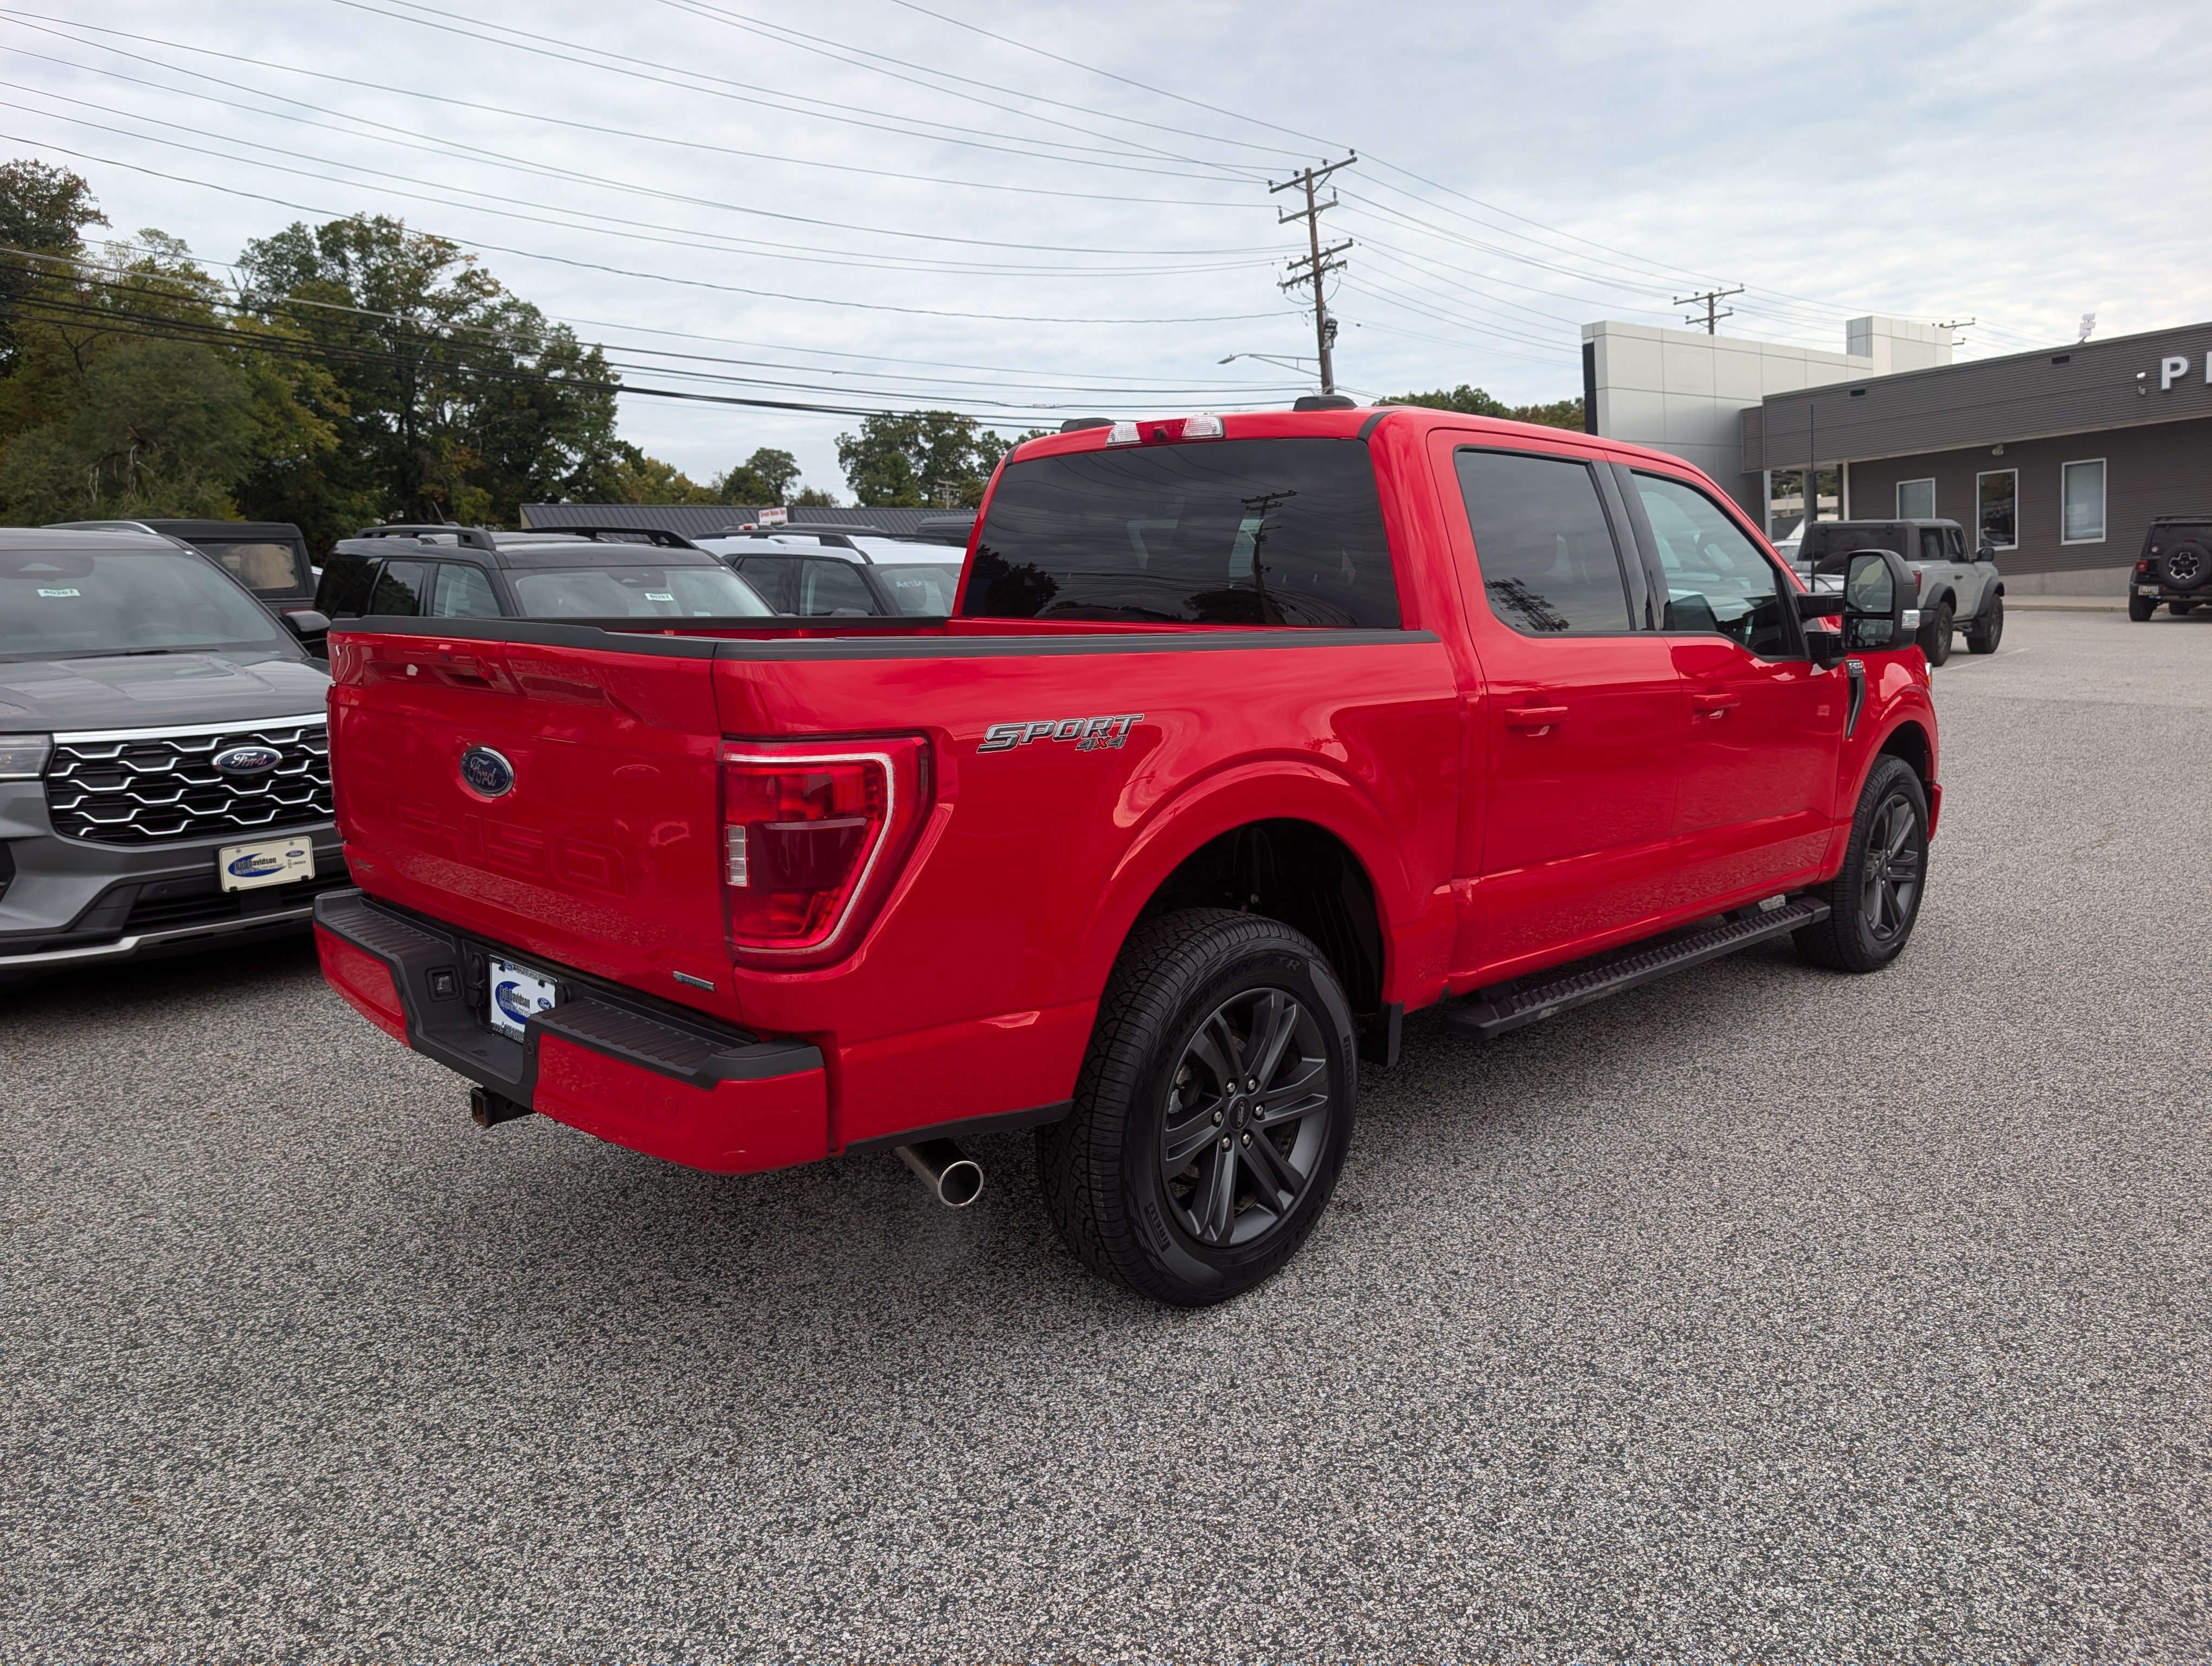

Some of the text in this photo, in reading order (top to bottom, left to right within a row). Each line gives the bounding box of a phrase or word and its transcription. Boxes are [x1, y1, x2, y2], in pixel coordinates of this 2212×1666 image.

[976, 714, 1145, 754] SPORT
[230, 752, 267, 767] Ford
[468, 756, 497, 787] Ford
[235, 857, 277, 869] Bob Davidson
[1259, 955, 1301, 971] ATR
[499, 984, 510, 999] Bob
[510, 988, 531, 1009] Davidson
[1143, 1200, 1172, 1253] PIRELLI
